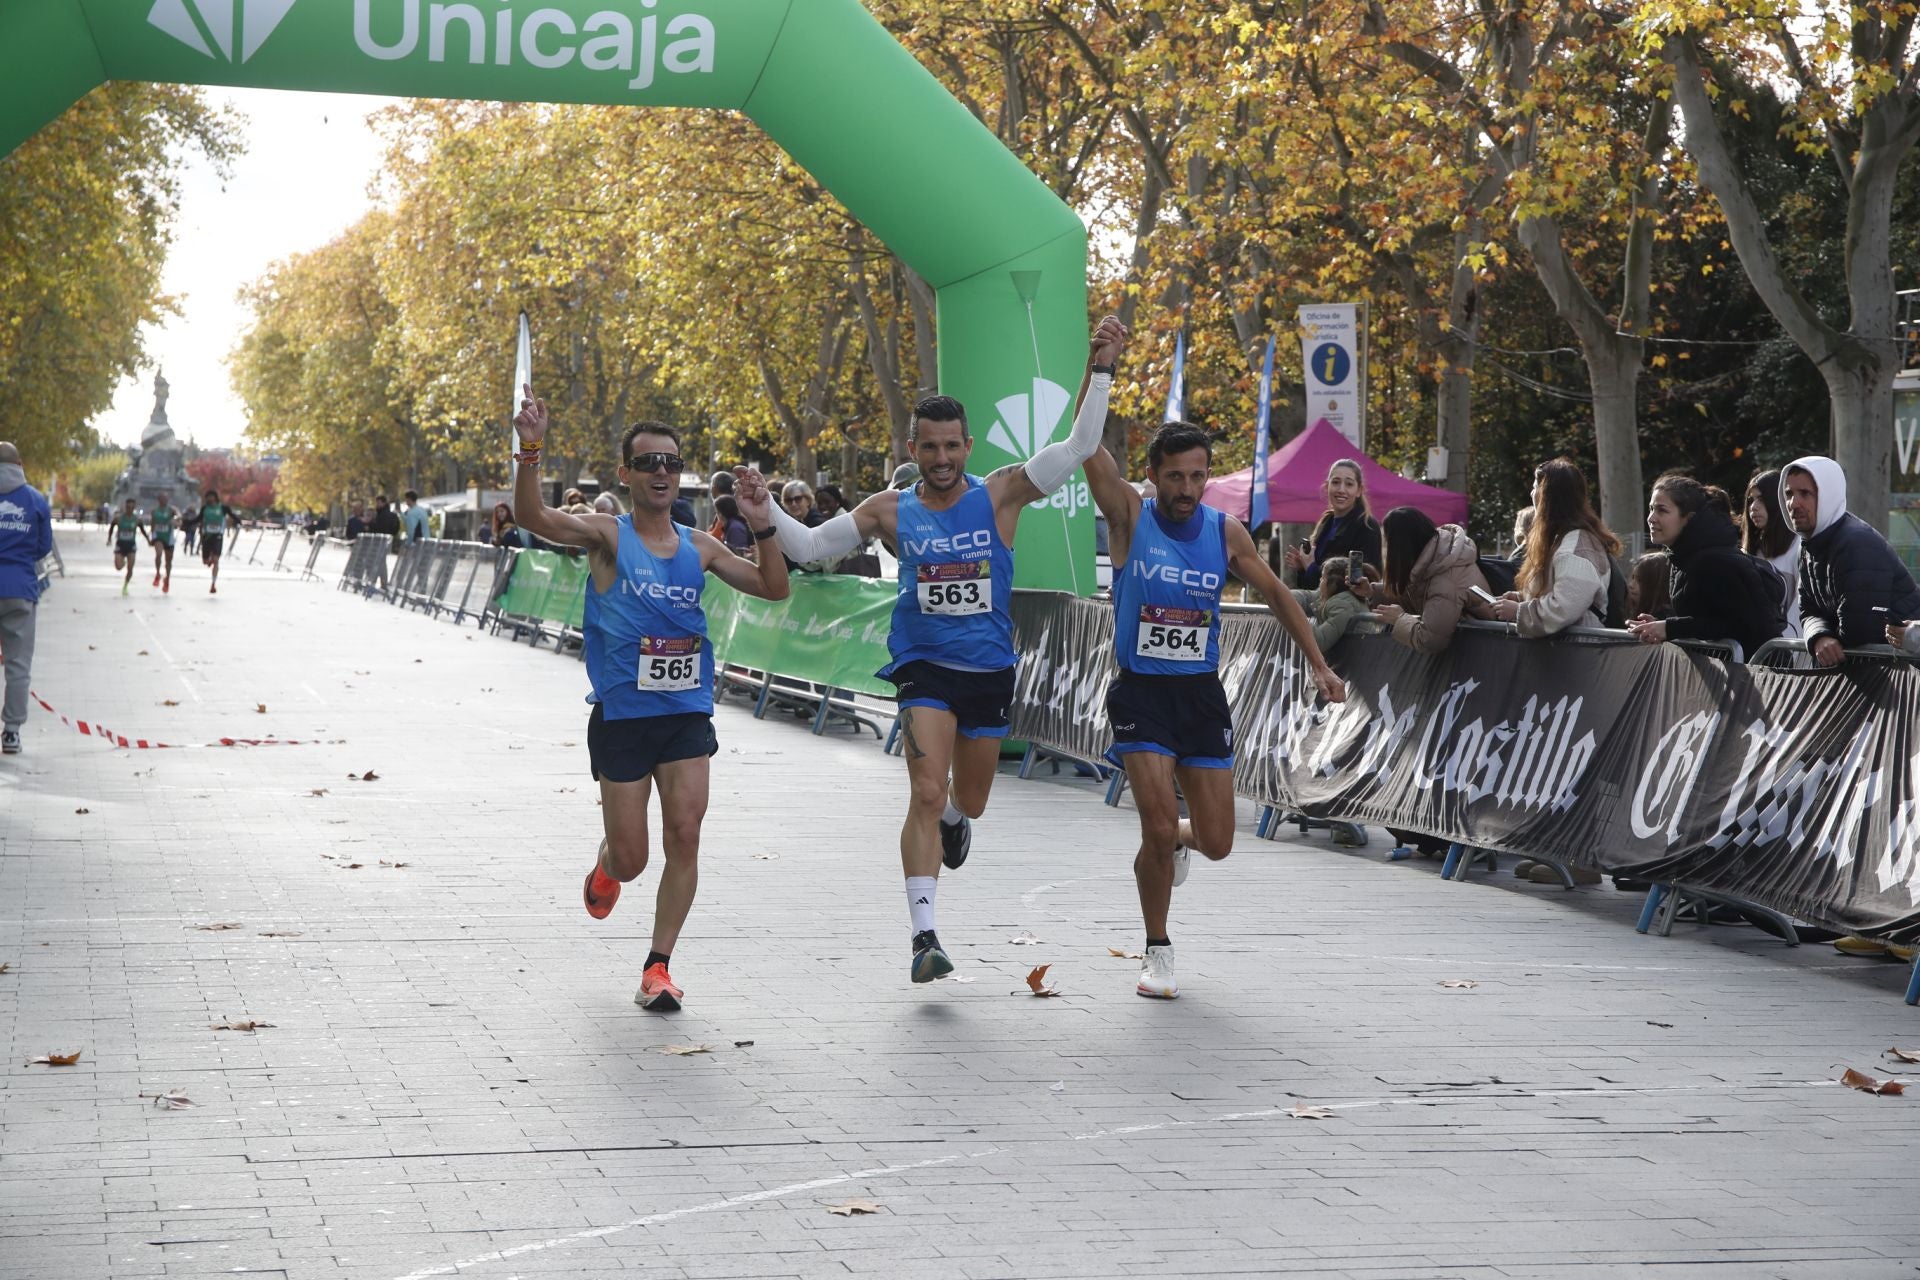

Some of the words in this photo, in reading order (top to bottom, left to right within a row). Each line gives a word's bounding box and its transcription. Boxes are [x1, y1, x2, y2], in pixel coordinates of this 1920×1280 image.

[353, 0, 716, 90] Unicaja
[1306, 312, 1331, 321] Oficina
[1332, 312, 1341, 320] de
[1895, 417, 1920, 475] V
[903, 529, 991, 556] IVECO
[962, 549, 991, 559] running
[1133, 559, 1220, 590] IVECO
[621, 578, 697, 603] IVECO
[928, 582, 980, 606] 563
[1148, 626, 1198, 650] 564
[649, 657, 694, 681] 565
[1357, 682, 1416, 786] de
[1412, 676, 1597, 817] Castilla
[1630, 709, 1722, 846] El
